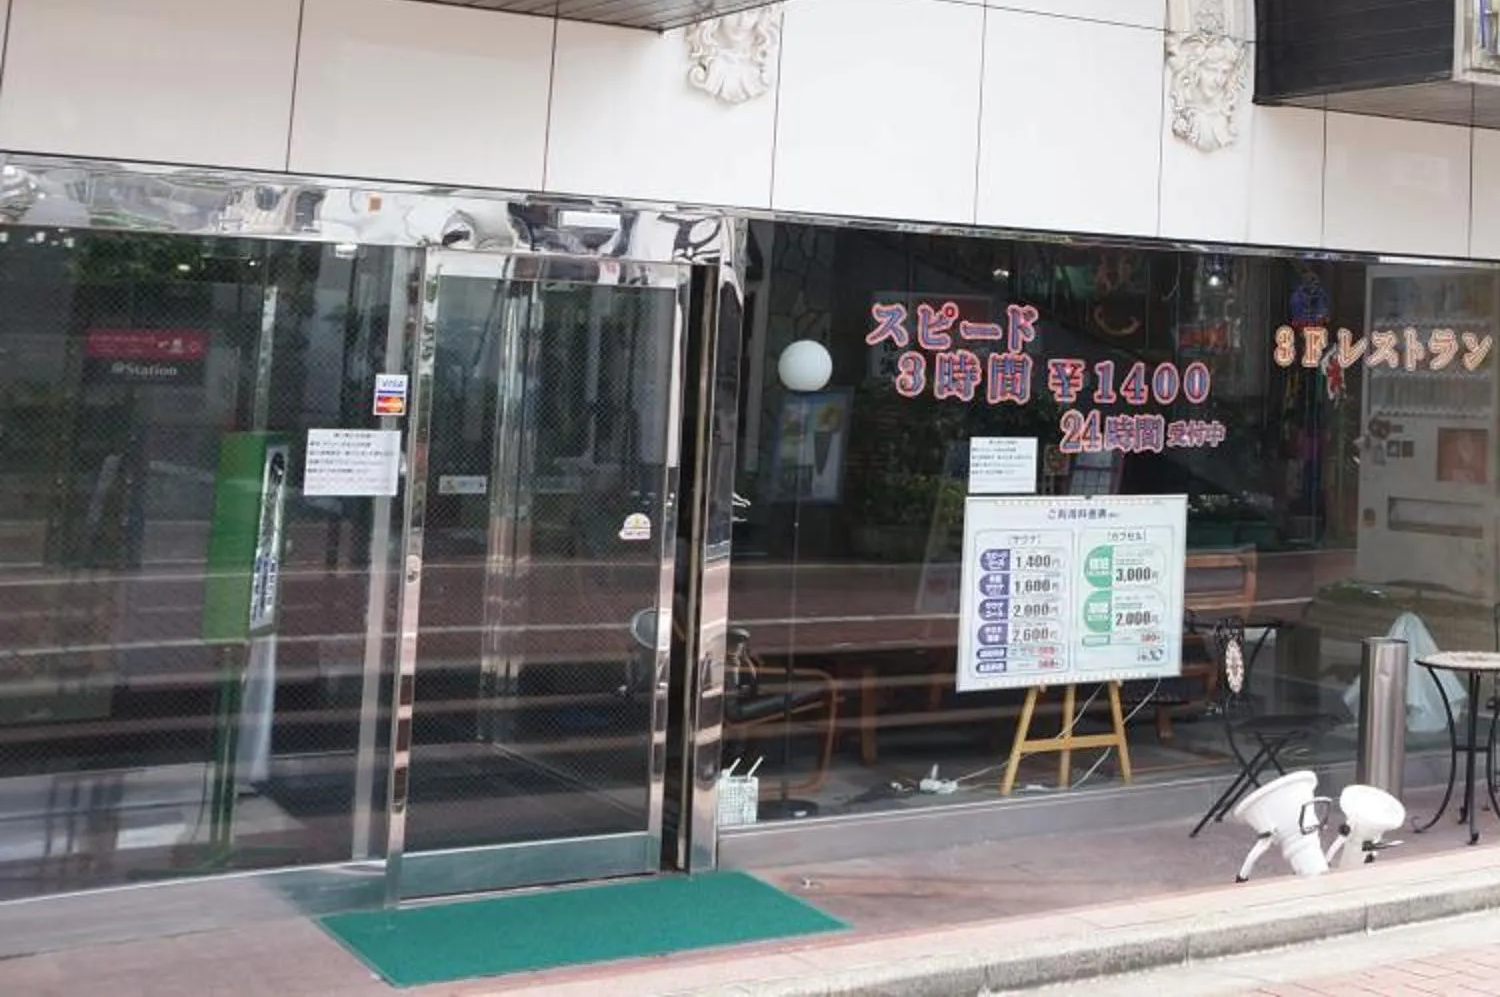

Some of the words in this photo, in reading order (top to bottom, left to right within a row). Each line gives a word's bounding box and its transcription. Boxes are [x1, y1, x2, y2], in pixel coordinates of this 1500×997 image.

[866, 302, 1039, 351] スピード
[896, 349, 1032, 404] 3時間
